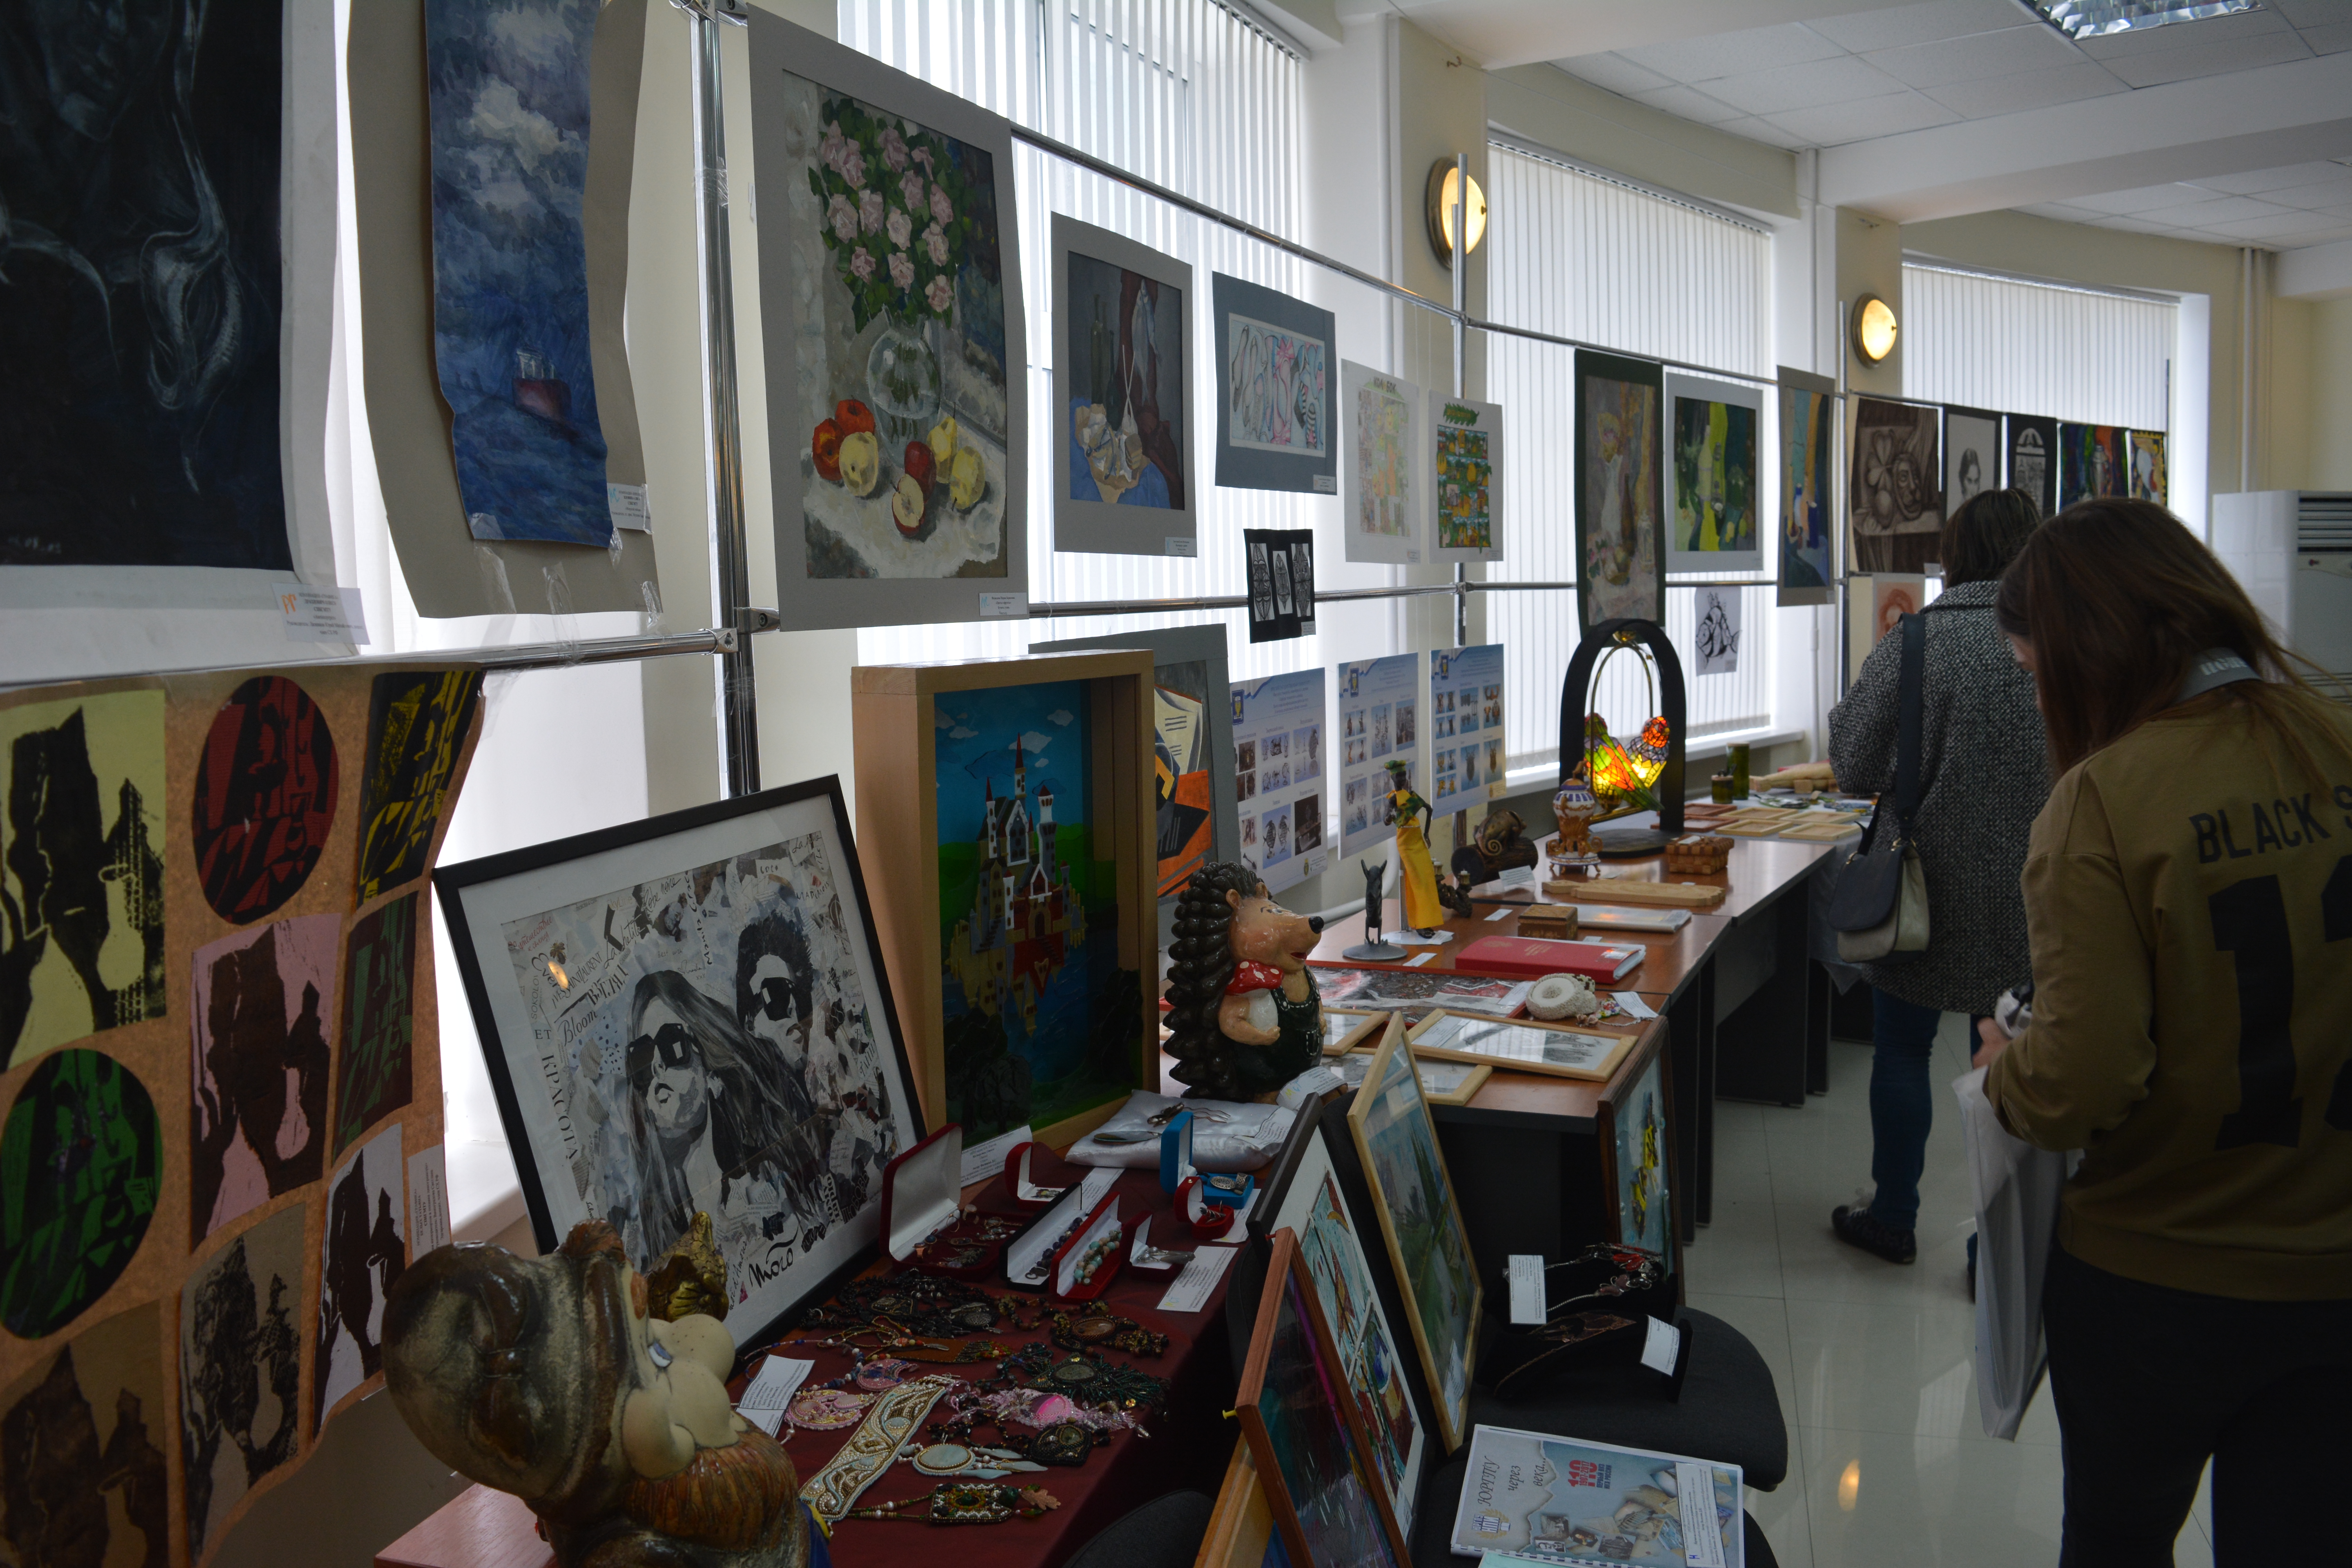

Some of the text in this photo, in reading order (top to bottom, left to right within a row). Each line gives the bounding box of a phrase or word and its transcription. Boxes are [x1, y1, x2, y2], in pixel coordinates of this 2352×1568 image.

[2189, 793, 2332, 864] BLACK
[557, 1010, 597, 1047] Bloom
[1477, 1455, 1500, 1506] ЮРГПУ
[1508, 1465, 1524, 1491] через
[1579, 1461, 1590, 1486] 1907-2017
